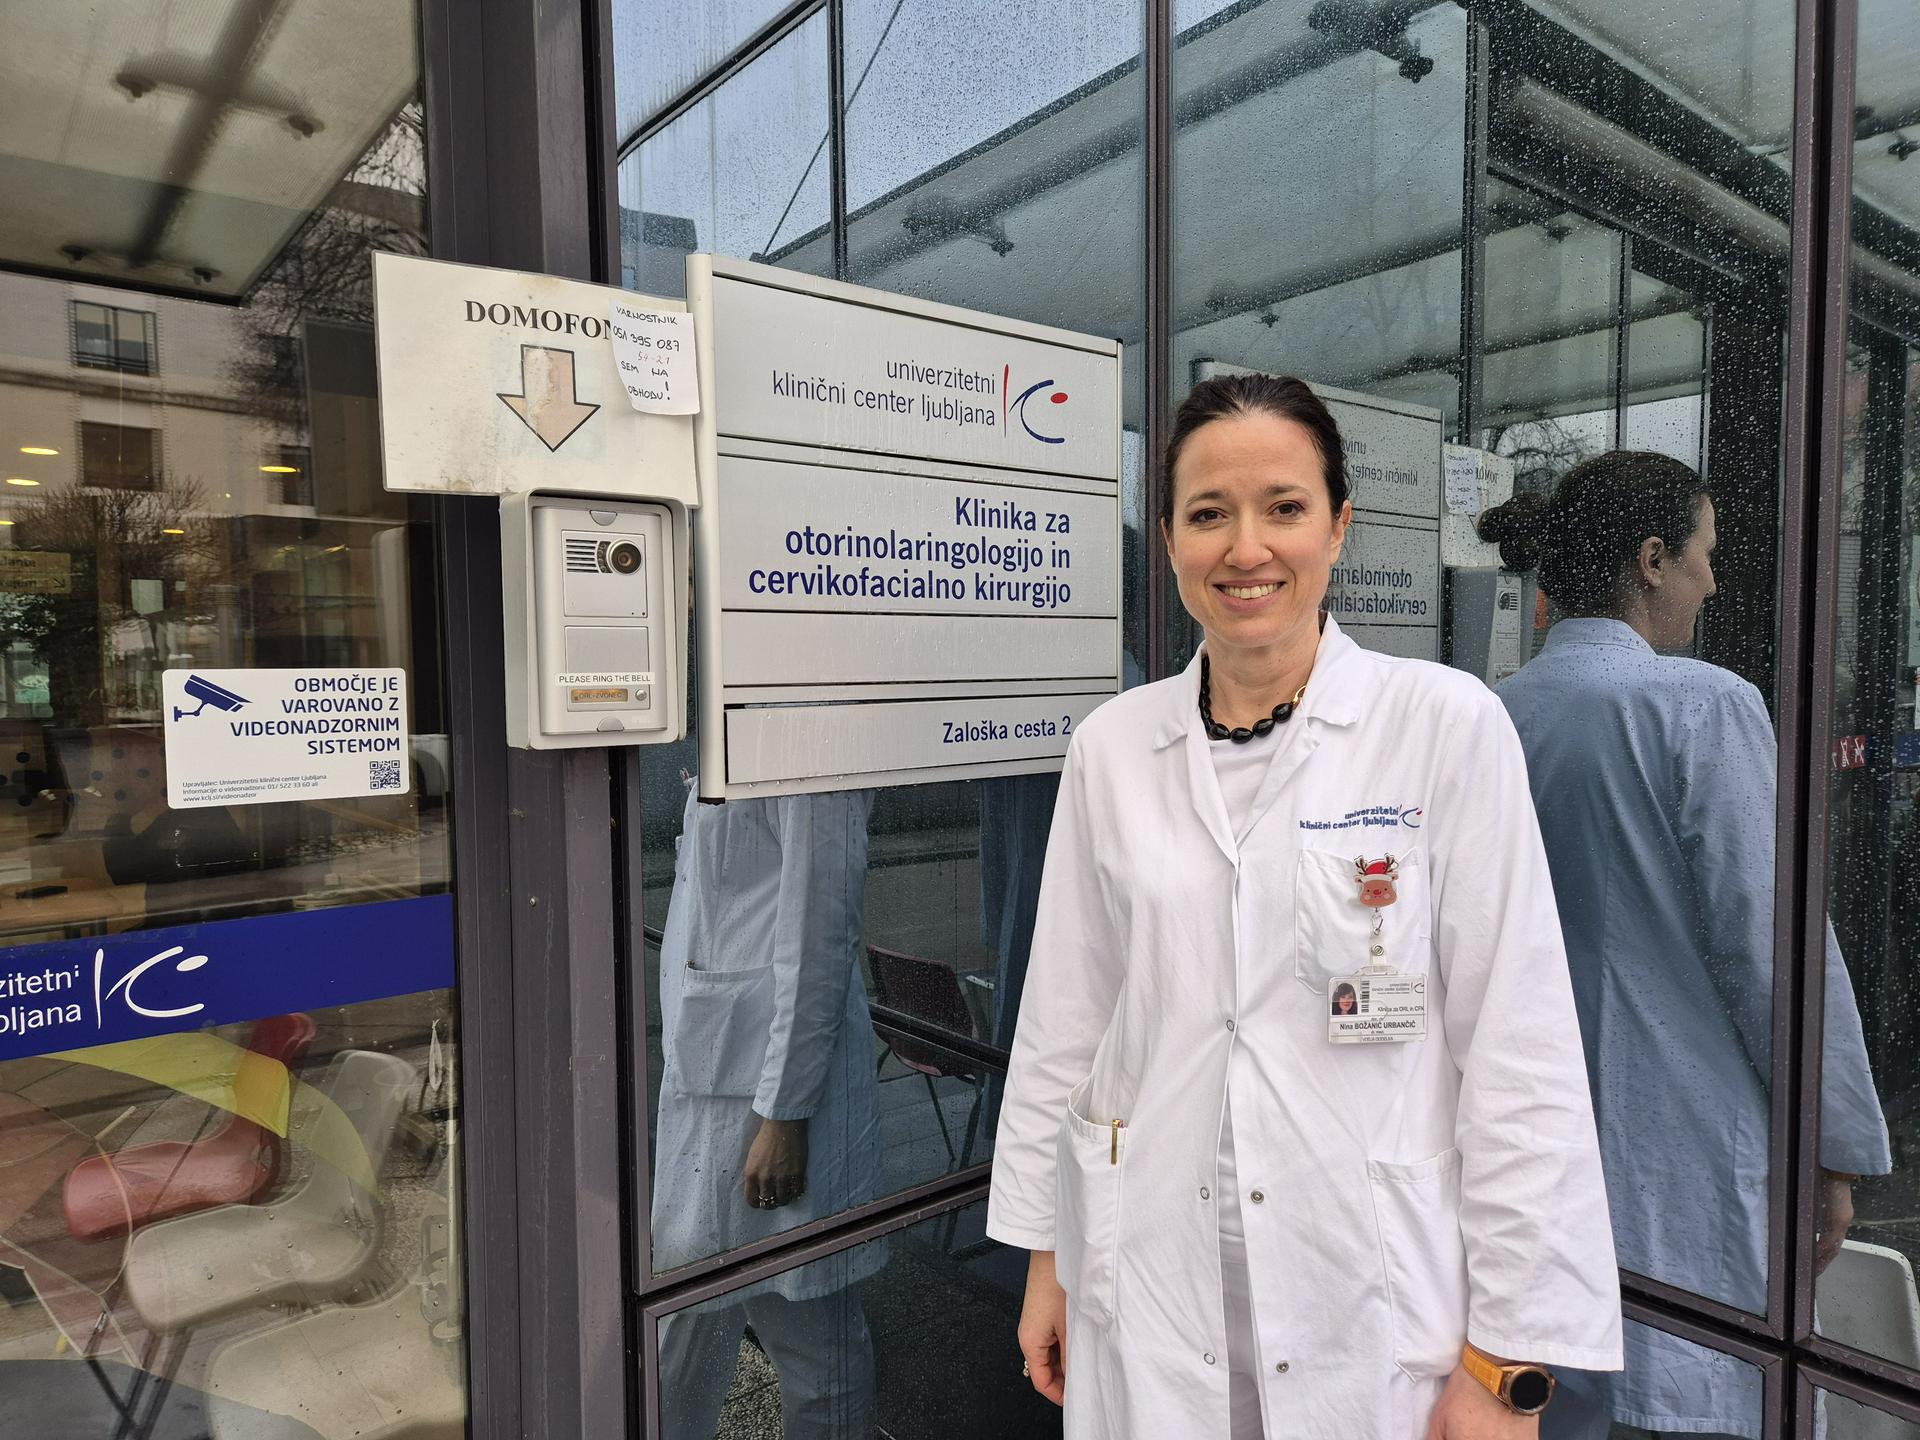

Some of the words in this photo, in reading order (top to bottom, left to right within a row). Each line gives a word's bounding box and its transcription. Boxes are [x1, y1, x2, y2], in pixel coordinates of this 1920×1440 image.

[616, 306, 678, 325] VARNOSTNIK
[630, 333, 651, 348] 395
[656, 339, 680, 352] 087
[620, 361, 640, 374] SEM
[651, 368, 669, 378] NA
[886, 360, 995, 395] univerzitetni
[773, 370, 846, 405] klinični
[853, 386, 915, 415] center
[921, 394, 995, 426] ljubljana
[955, 496, 1036, 531] Klinika
[1045, 512, 1070, 534] za
[785, 525, 1043, 573] otorinolaringologijo
[1051, 540, 1071, 569] in
[749, 564, 966, 601] cervikofacialno
[975, 572, 1071, 609] kirurgijo
[294, 674, 377, 694] OBMOČJE
[382, 677, 398, 694] JE
[559, 675, 591, 683] PLEASE
[593, 675, 613, 683] RING
[615, 674, 630, 682] THE
[631, 674, 650, 682] BELL
[282, 698, 383, 714] VAROVANO
[389, 697, 399, 711] Z
[231, 717, 399, 737] VIDEONADZORNIM
[943, 720, 1008, 743] Zaloška
[1014, 718, 1056, 738] cesta
[1062, 715, 1071, 735] 2
[307, 738, 400, 755] SISTEMOM
[301, 774, 327, 782] Ljubljana
[183, 787, 217, 796] Informacije
[1300, 820, 1331, 830] klinični
[1332, 820, 1360, 829] center
